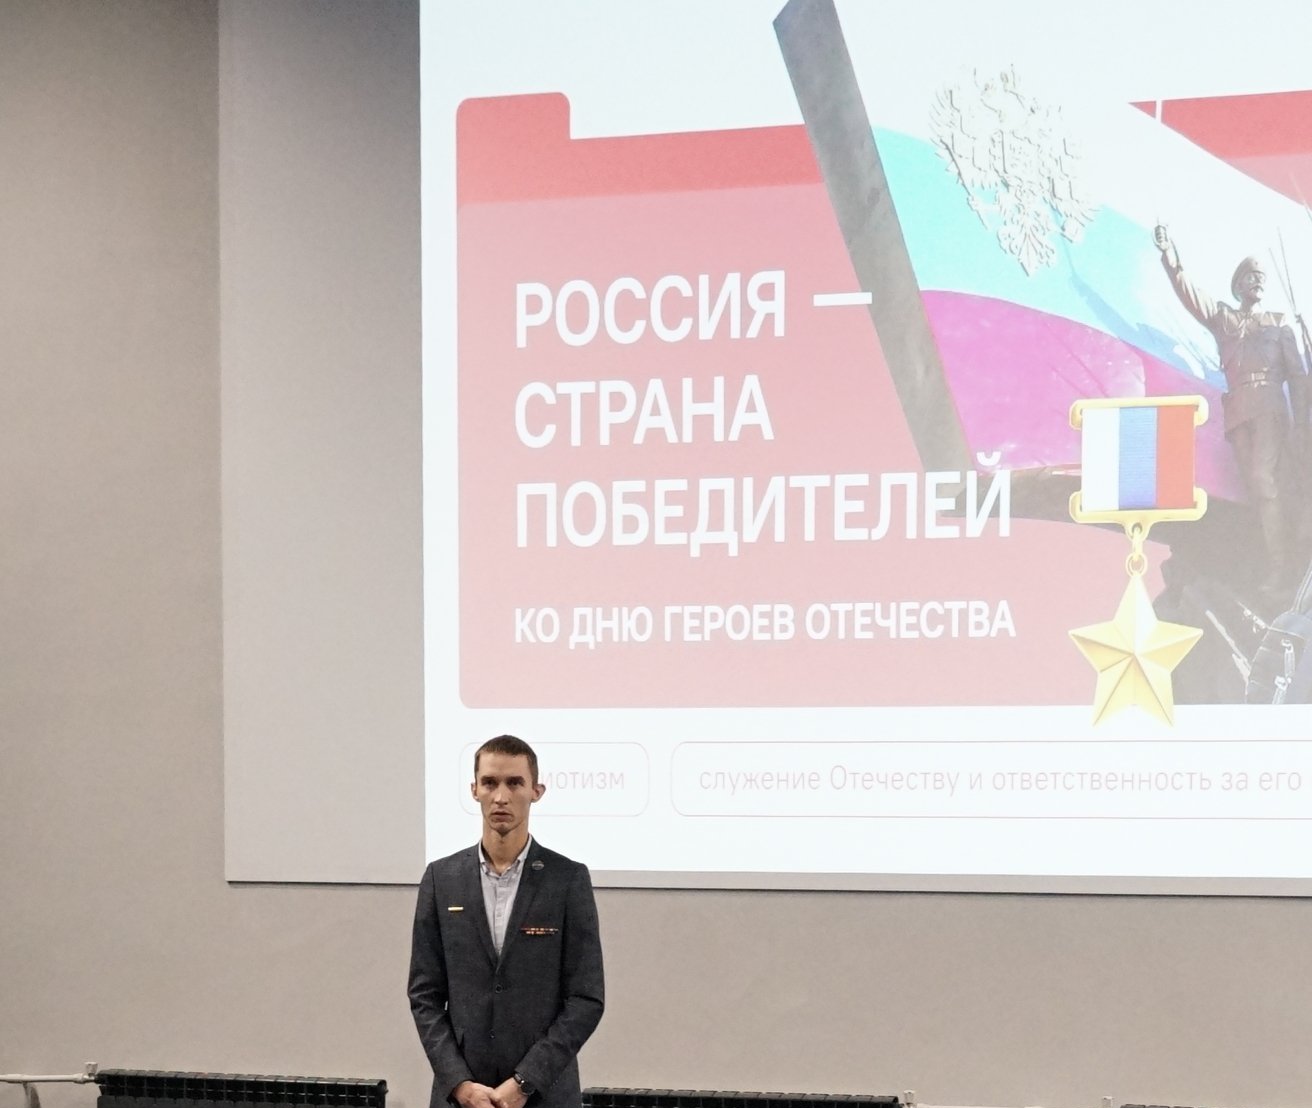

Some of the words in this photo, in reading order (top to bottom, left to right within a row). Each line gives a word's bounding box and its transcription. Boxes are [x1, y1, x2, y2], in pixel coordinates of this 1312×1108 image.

[515, 270, 786, 348] РОССИЯ
[514, 374, 775, 448] СТРАНА
[515, 452, 1012, 557] ПОБЕДИТЕЛЕЙ
[514, 607, 560, 645] КО
[568, 605, 653, 650] ДНЮ
[664, 602, 795, 642] ГЕРОЕВ
[805, 600, 1016, 640] ОТЕЧЕСТВА
[542, 770, 625, 790] иотизм
[699, 767, 820, 797] служение
[829, 765, 959, 797] Отечеству
[970, 771, 983, 790] и
[992, 769, 1212, 791] ответственность
[1221, 771, 1249, 791] за
[1259, 770, 1302, 791] его
